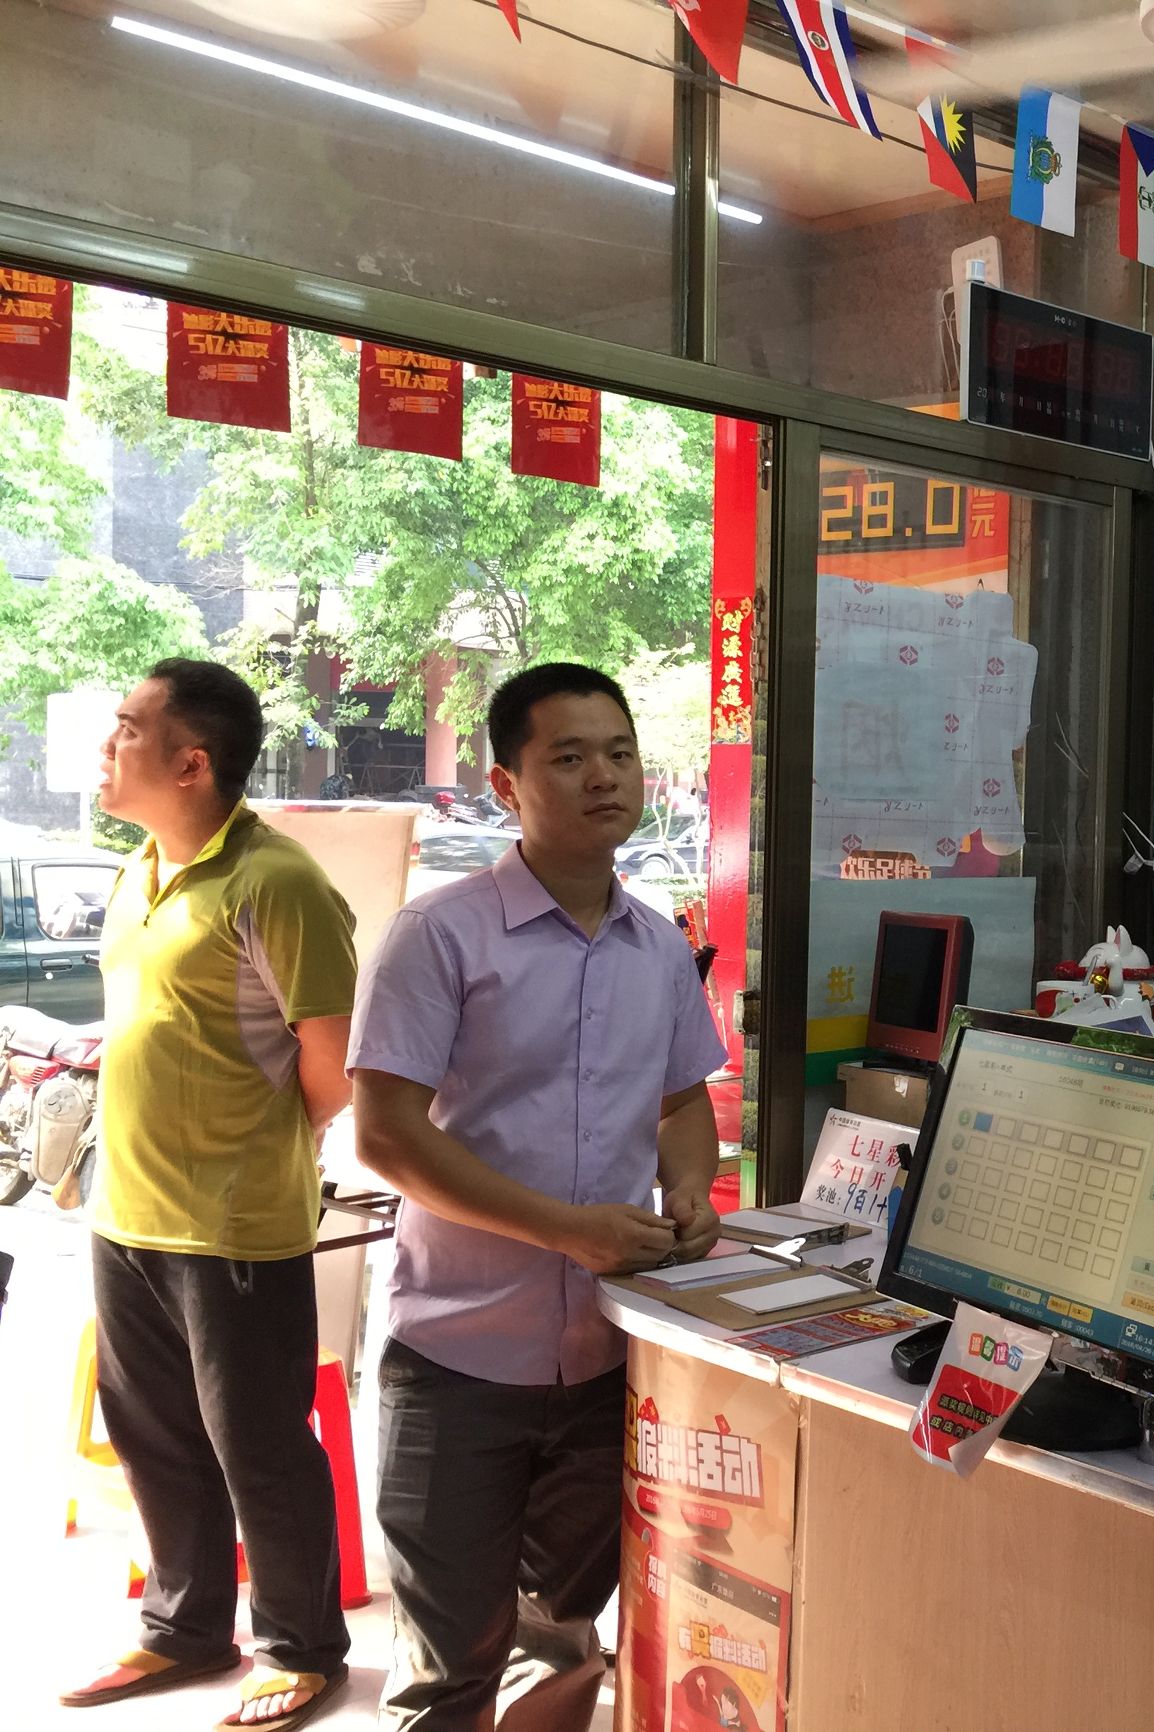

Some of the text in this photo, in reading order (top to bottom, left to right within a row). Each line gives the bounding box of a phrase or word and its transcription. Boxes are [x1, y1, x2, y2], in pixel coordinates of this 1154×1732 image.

[821, 479, 961, 541] 28.0
[849, 1135, 901, 1168] 七星彩
[831, 1158, 886, 1191] 今日开
